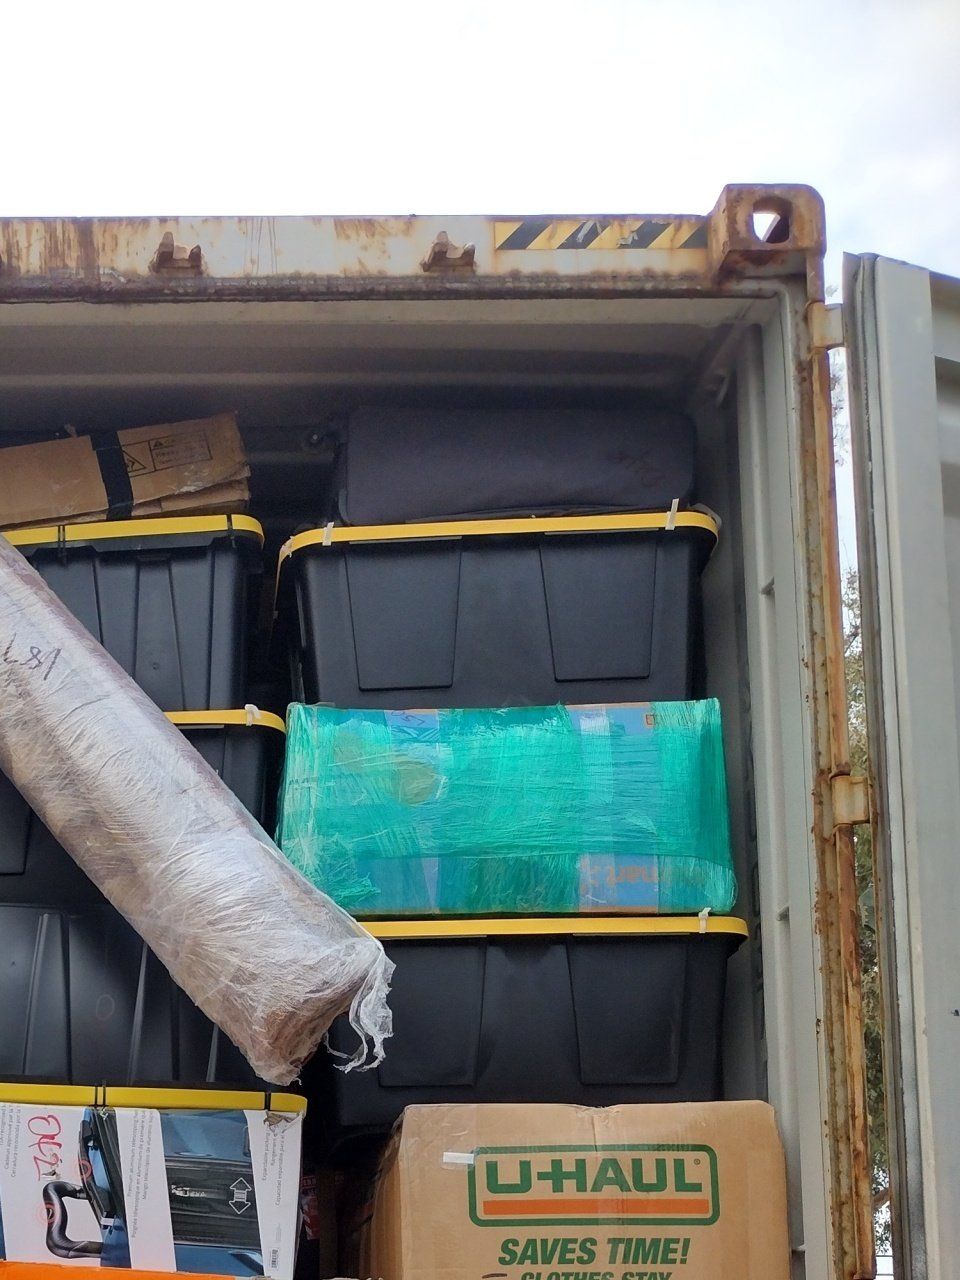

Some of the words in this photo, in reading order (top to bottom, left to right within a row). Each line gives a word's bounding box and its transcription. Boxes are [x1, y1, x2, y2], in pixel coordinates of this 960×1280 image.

[486, 1157, 703, 1195] U-HAUL
[498, 1238, 596, 1266] SAVES
[605, 1237, 691, 1265] TIME!
